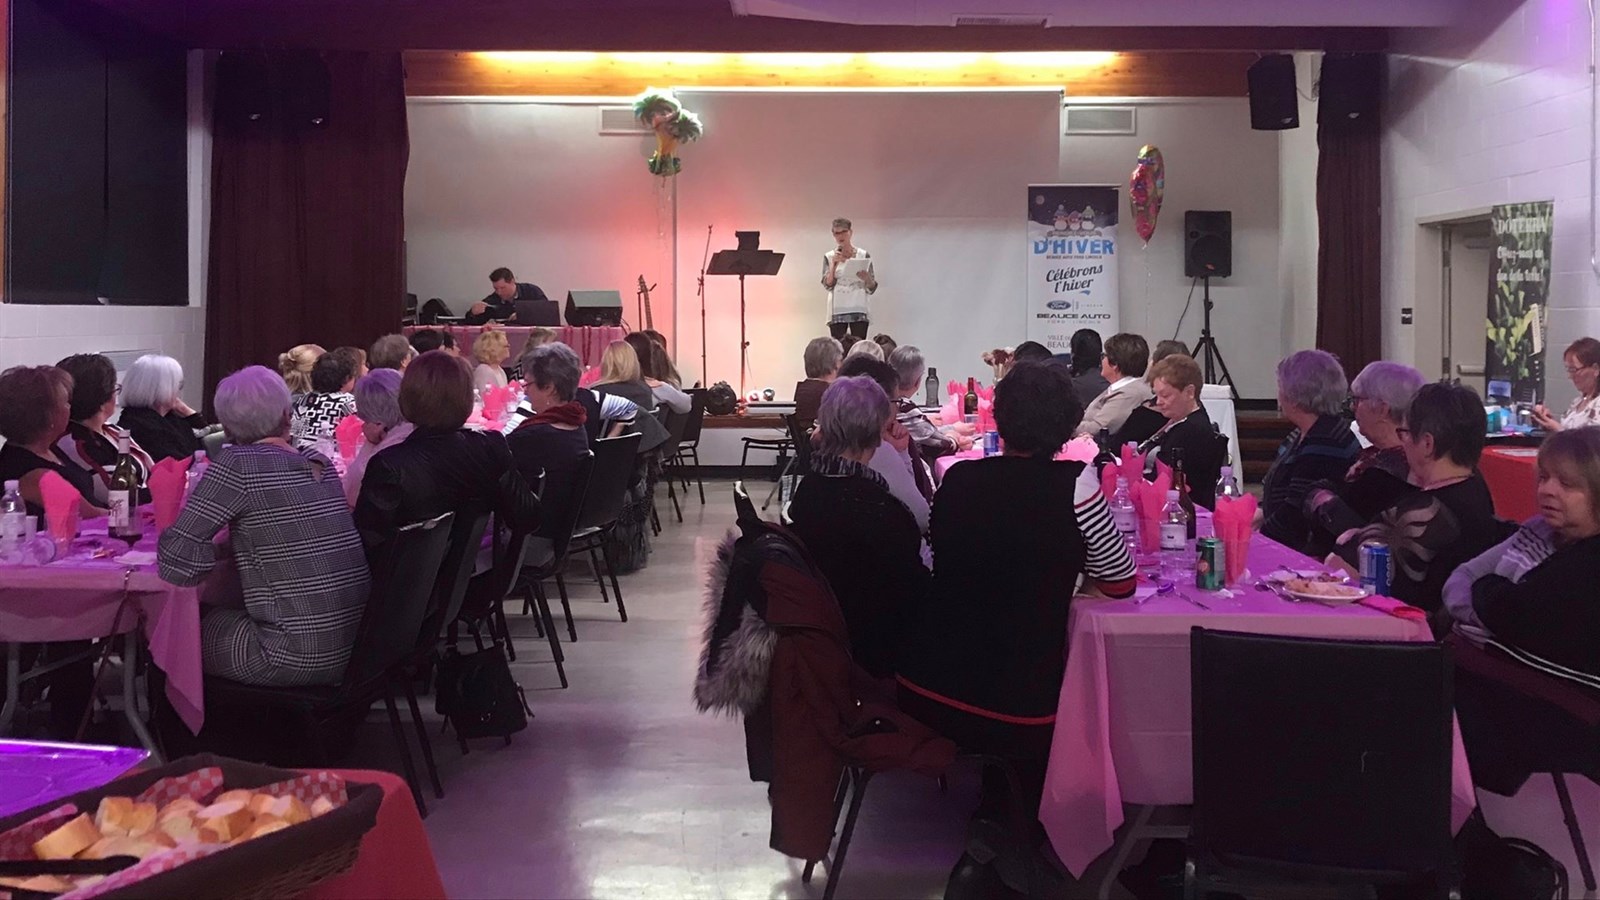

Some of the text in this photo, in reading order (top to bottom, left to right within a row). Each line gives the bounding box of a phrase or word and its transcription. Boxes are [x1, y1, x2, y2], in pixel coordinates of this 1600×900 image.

[1034, 238, 1114, 254] D'HIVER
[1046, 264, 1103, 282] Célébrons
[1054, 279, 1094, 293] l'hiver
